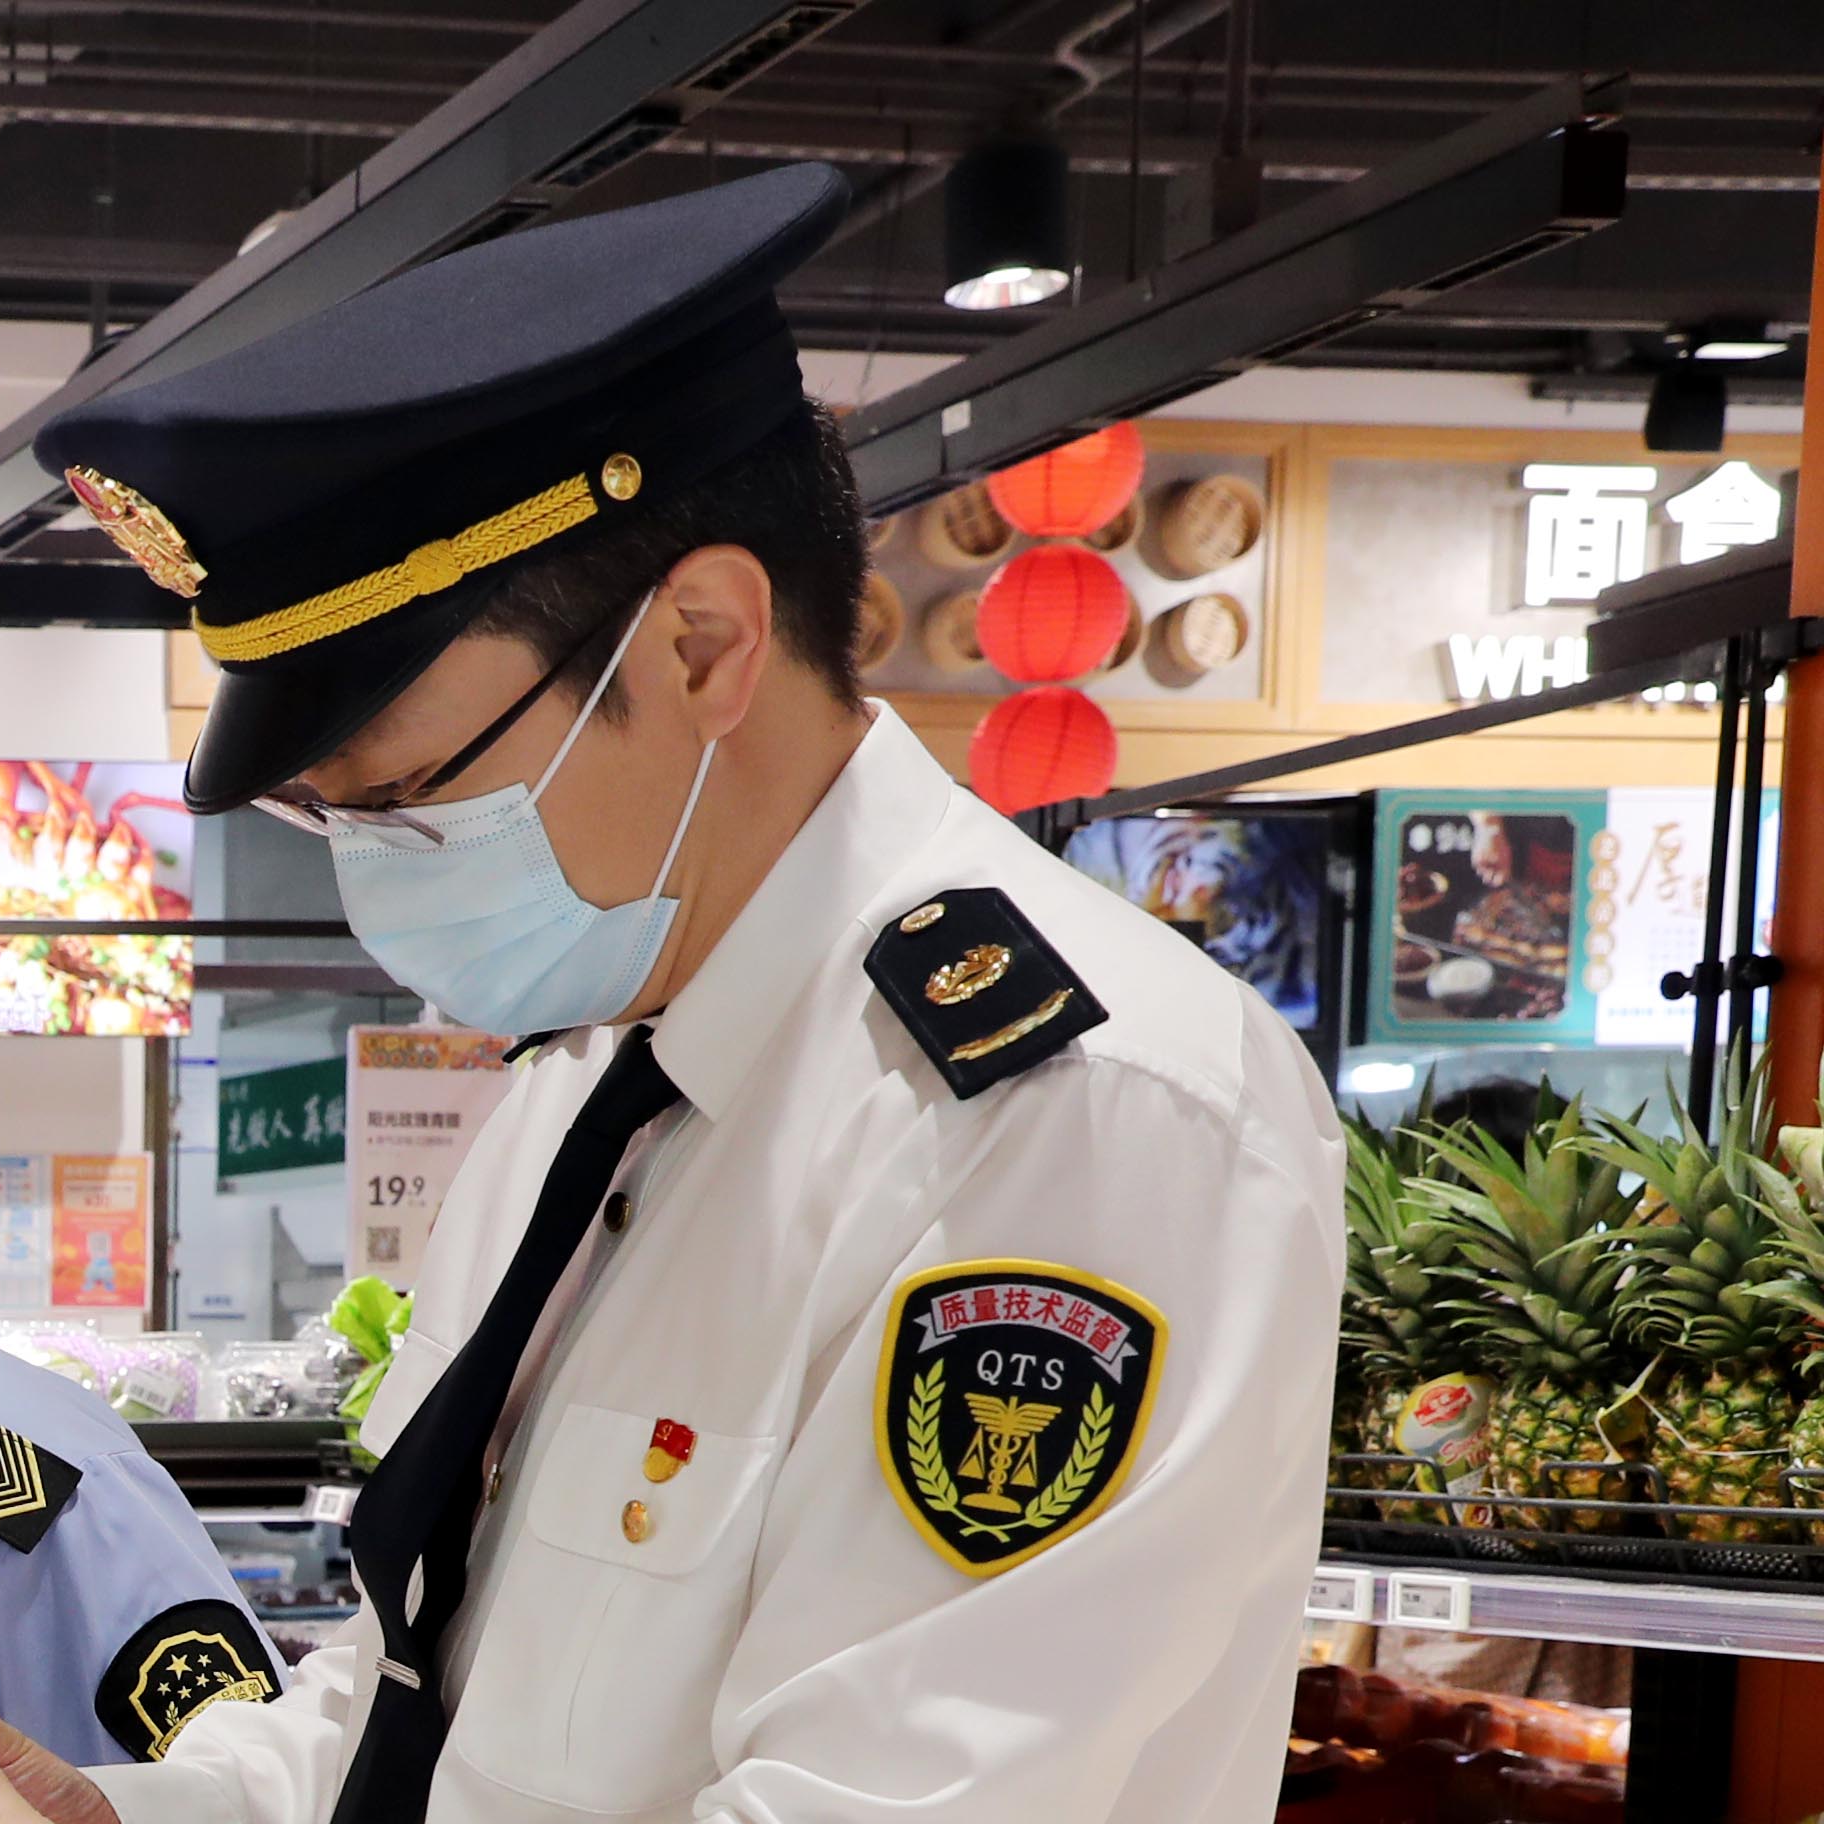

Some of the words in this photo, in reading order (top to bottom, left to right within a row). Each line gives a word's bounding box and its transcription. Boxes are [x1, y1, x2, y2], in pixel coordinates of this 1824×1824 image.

[367, 1176, 426, 1207] 19.9
[938, 1289, 1123, 1354] 质量技术监督
[976, 1348, 1066, 1392] QTS
